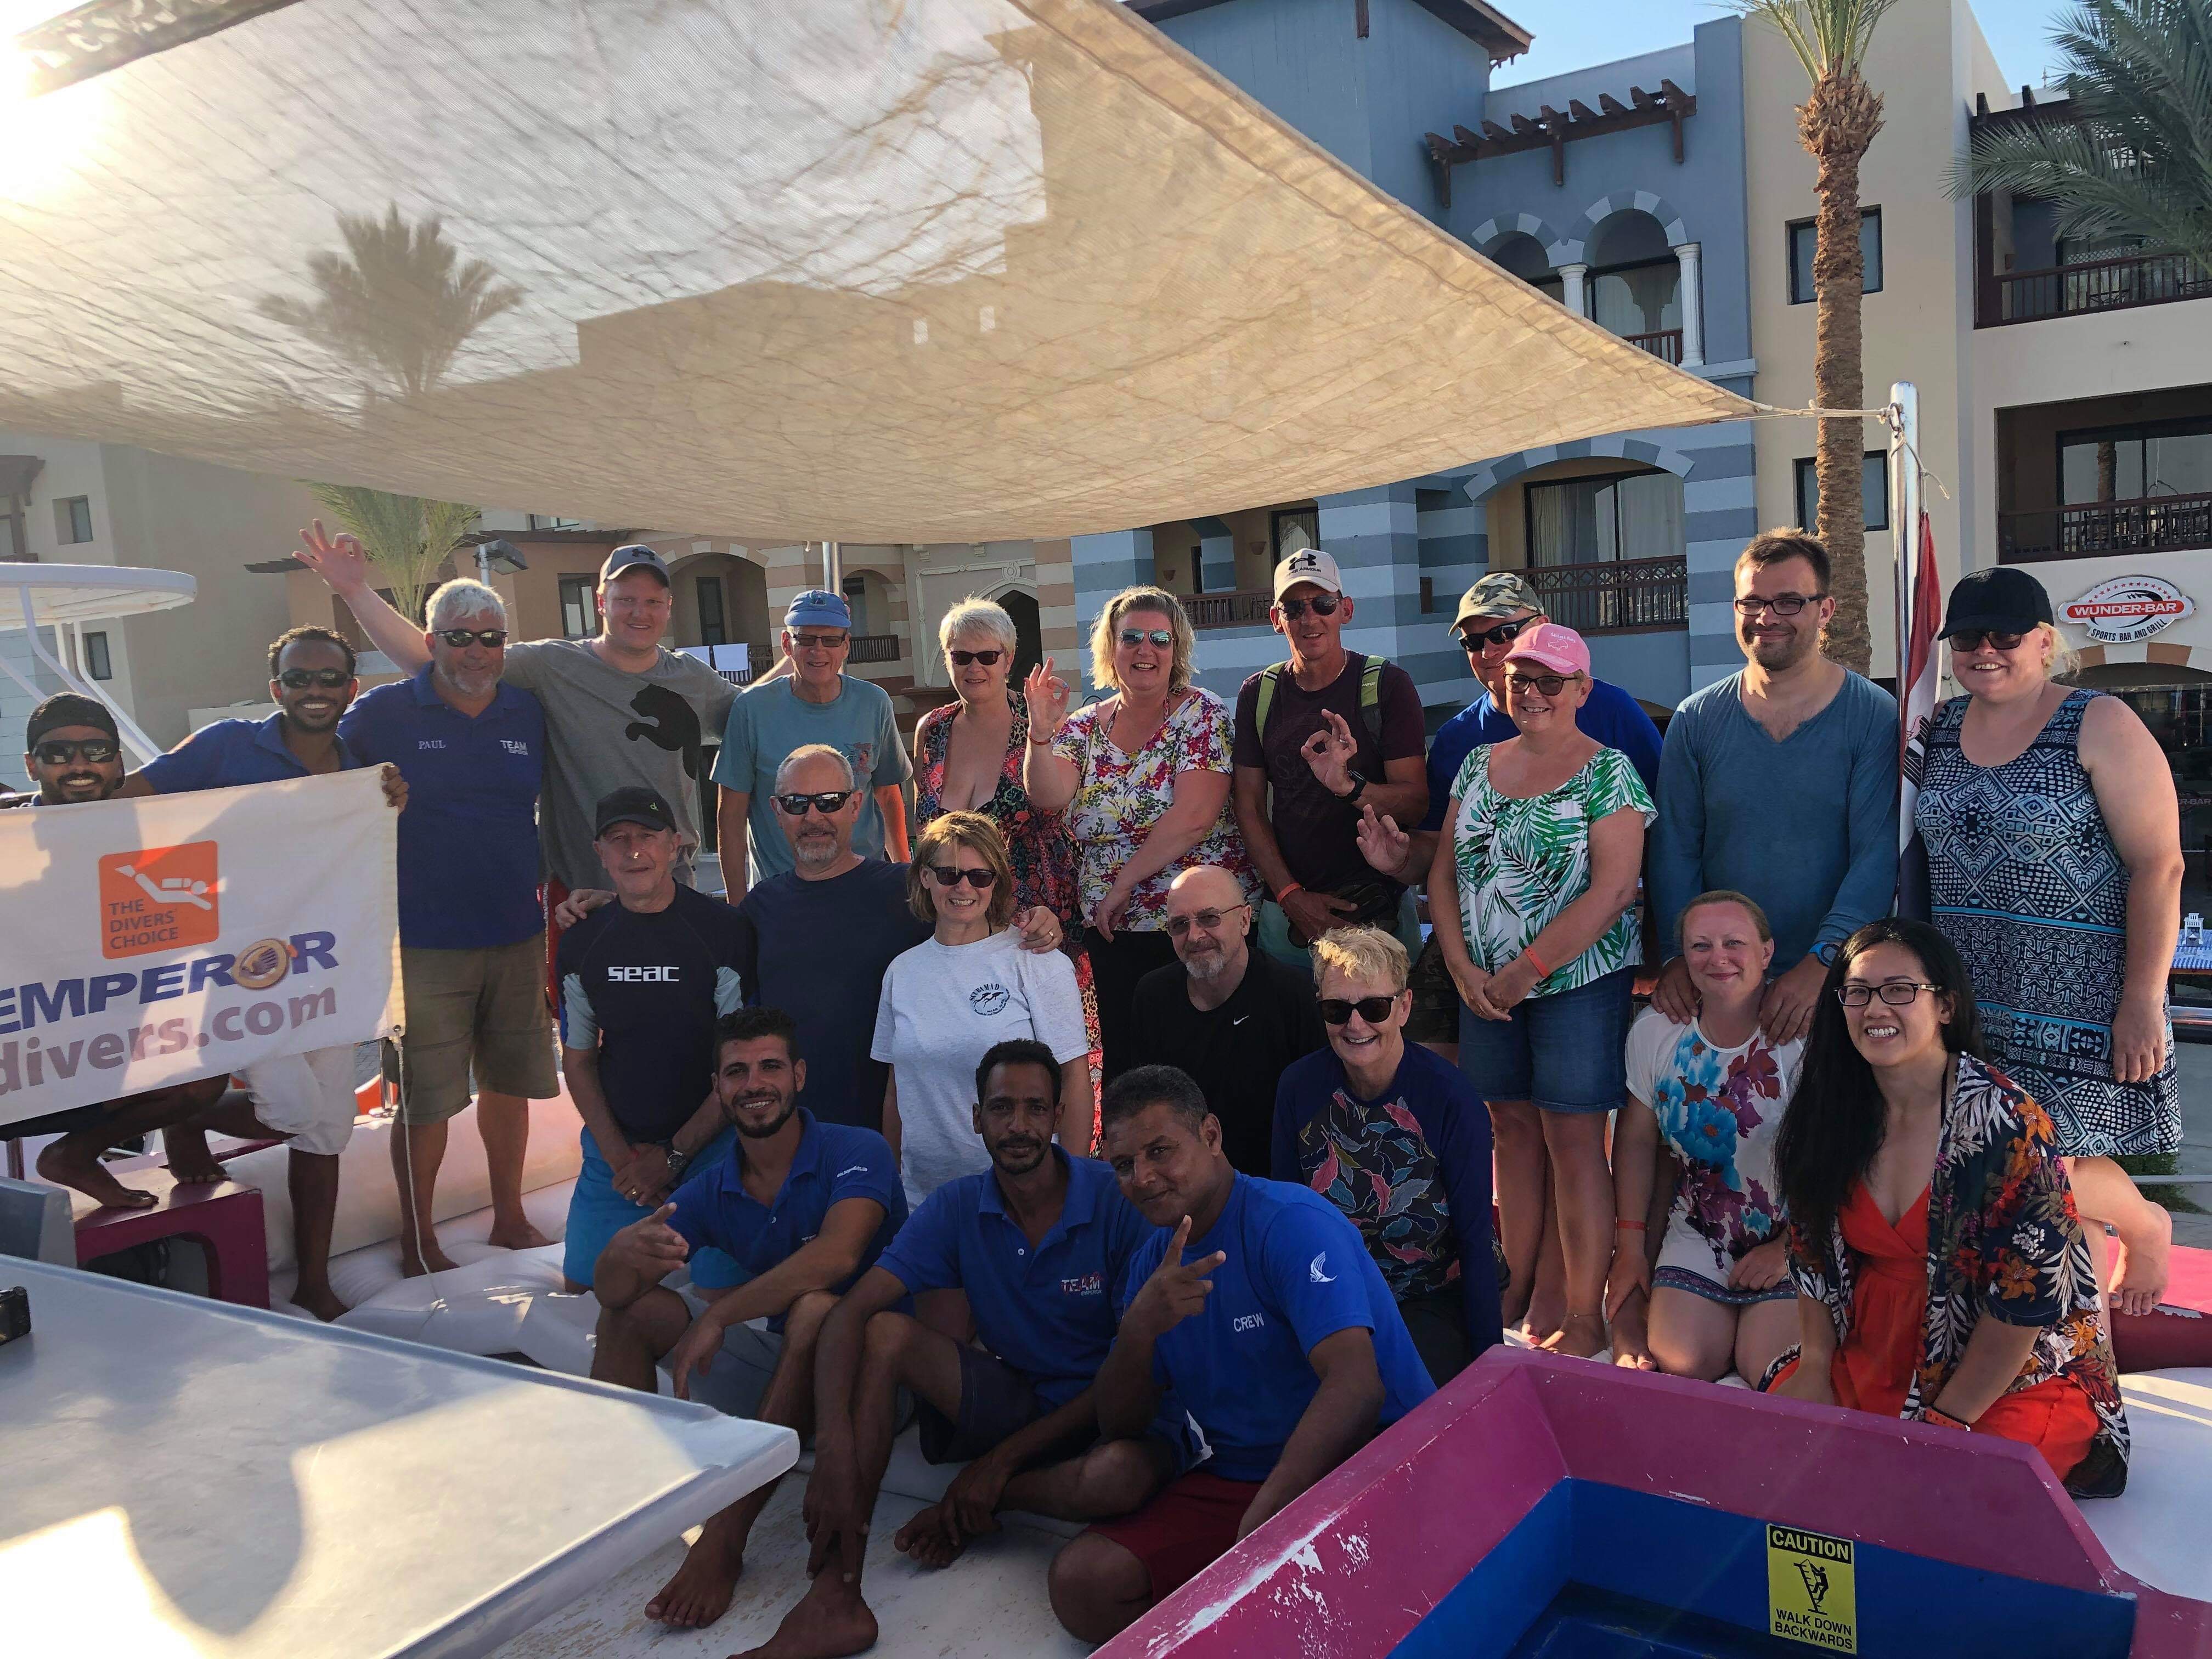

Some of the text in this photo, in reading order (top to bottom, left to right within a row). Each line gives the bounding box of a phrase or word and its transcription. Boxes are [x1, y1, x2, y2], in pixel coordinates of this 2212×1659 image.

[2074, 602, 2177, 616] WUNDER-BAR
[2091, 619, 2167, 641] SPORTS BAR AND GRILL
[417, 740, 527, 751] PAUL TEAM
[108, 899, 144, 915] THE
[110, 927, 179, 949] CHOICE
[0, 987, 336, 1096] divers.com
[1061, 1276, 1100, 1292] TEAM
[1233, 1312, 1264, 1332] CREW
[1772, 1530, 1848, 1560] CAUTION
[1776, 1608, 1852, 1636] WALK DOWN
[1775, 1622, 1853, 1650] BACKWARDS
